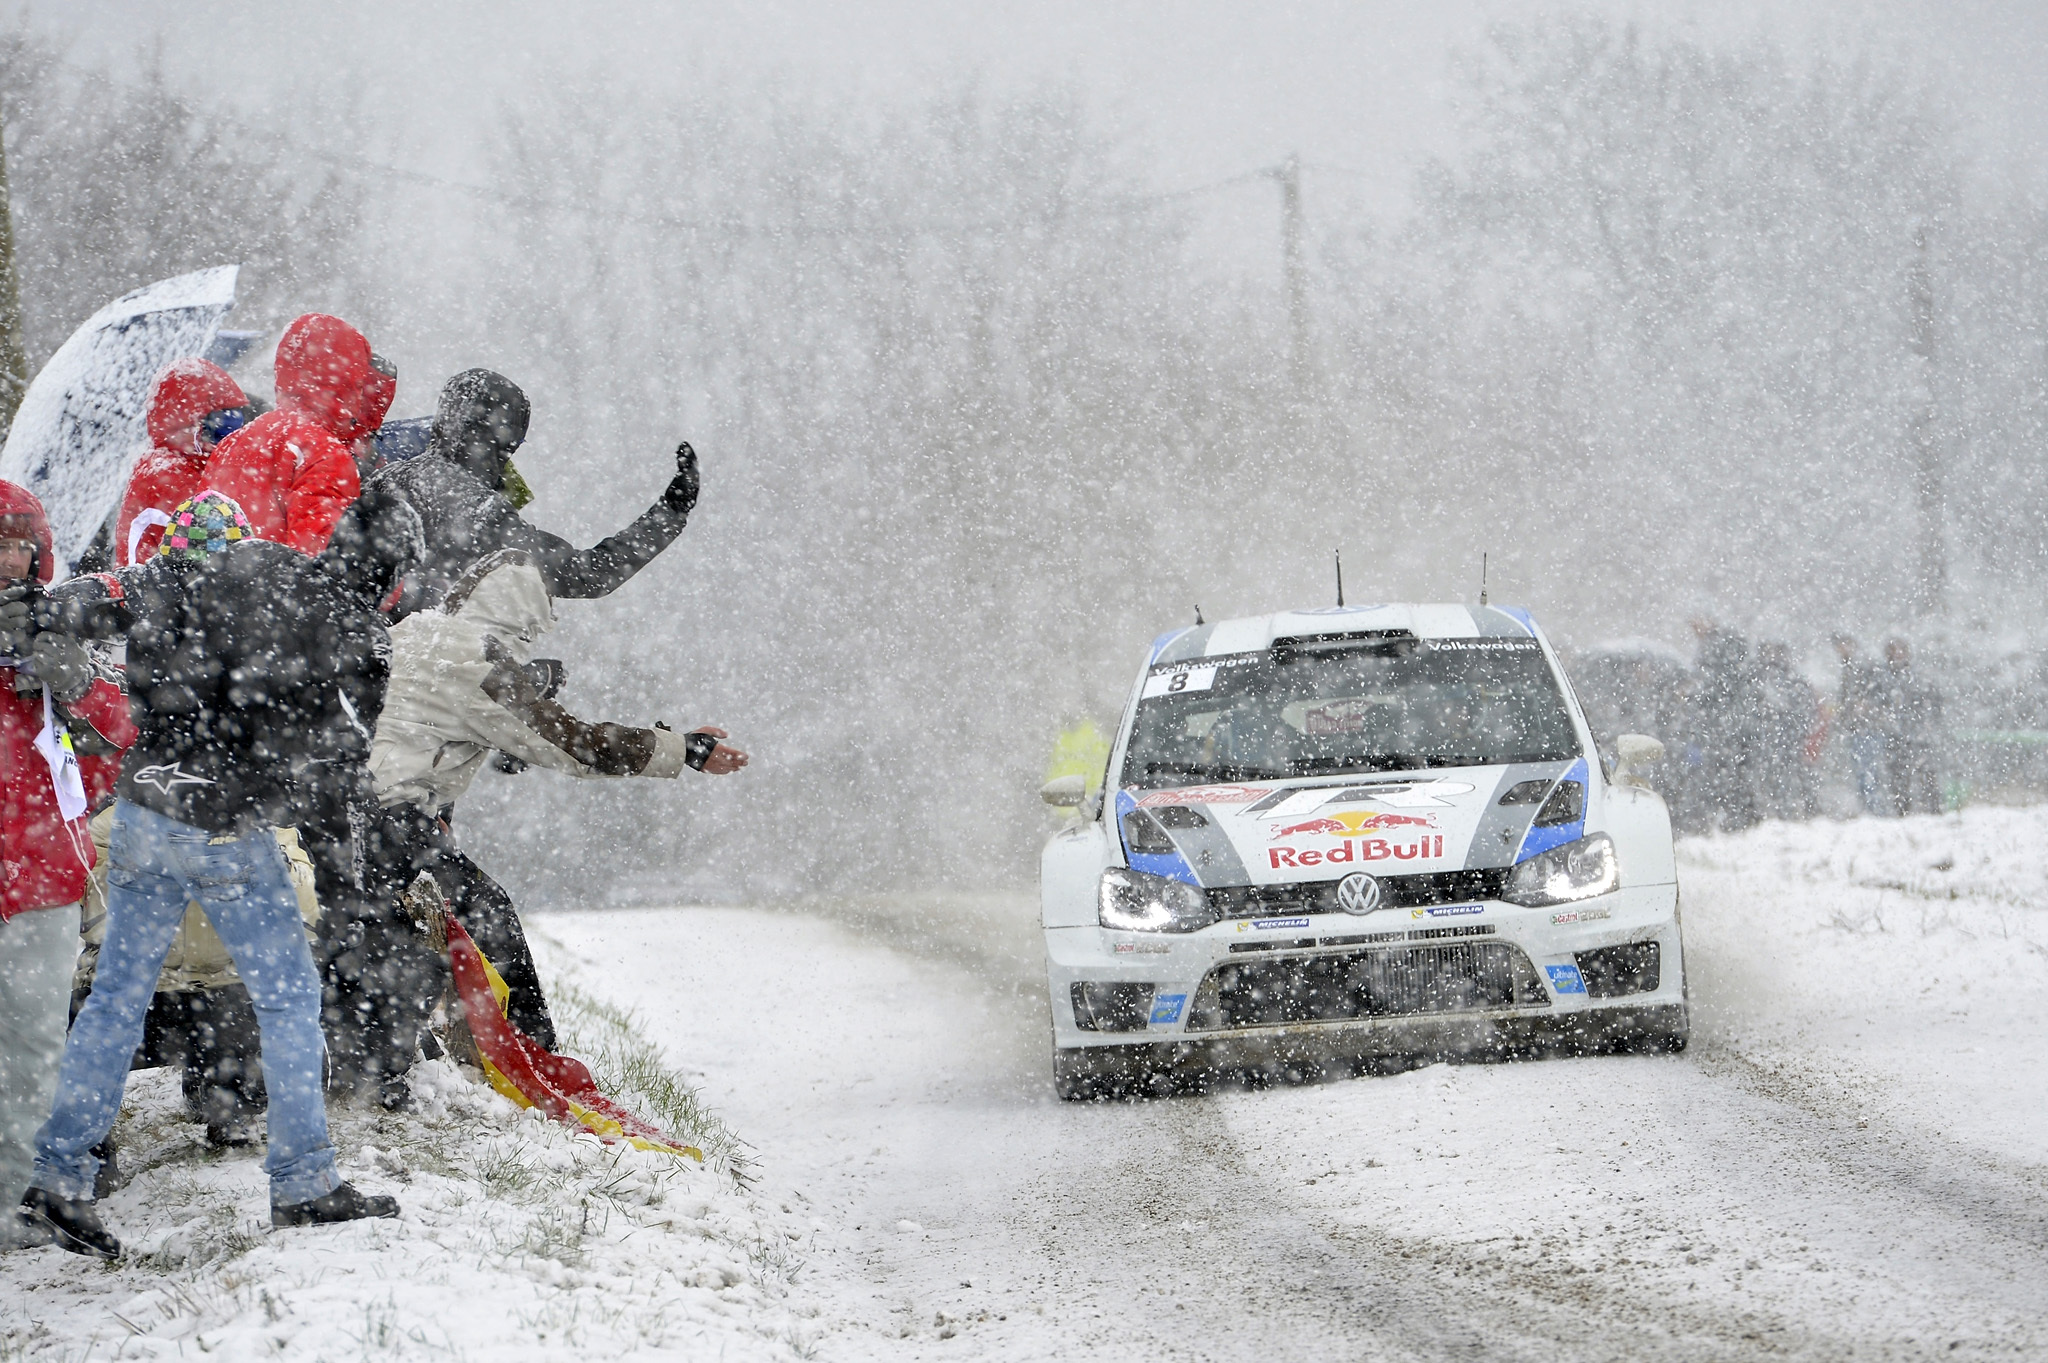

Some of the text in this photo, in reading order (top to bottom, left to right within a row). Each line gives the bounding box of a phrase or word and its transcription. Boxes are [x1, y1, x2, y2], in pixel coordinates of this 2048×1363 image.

[1428, 641, 1537, 652] Volkswagen
[1154, 657, 1259, 676] Volkswagen
[1168, 672, 1189, 692] 8
[1268, 835, 1443, 869] Red Bull
[1433, 906, 1483, 915] MICHELIN
[1258, 919, 1308, 928] MICHELIN
